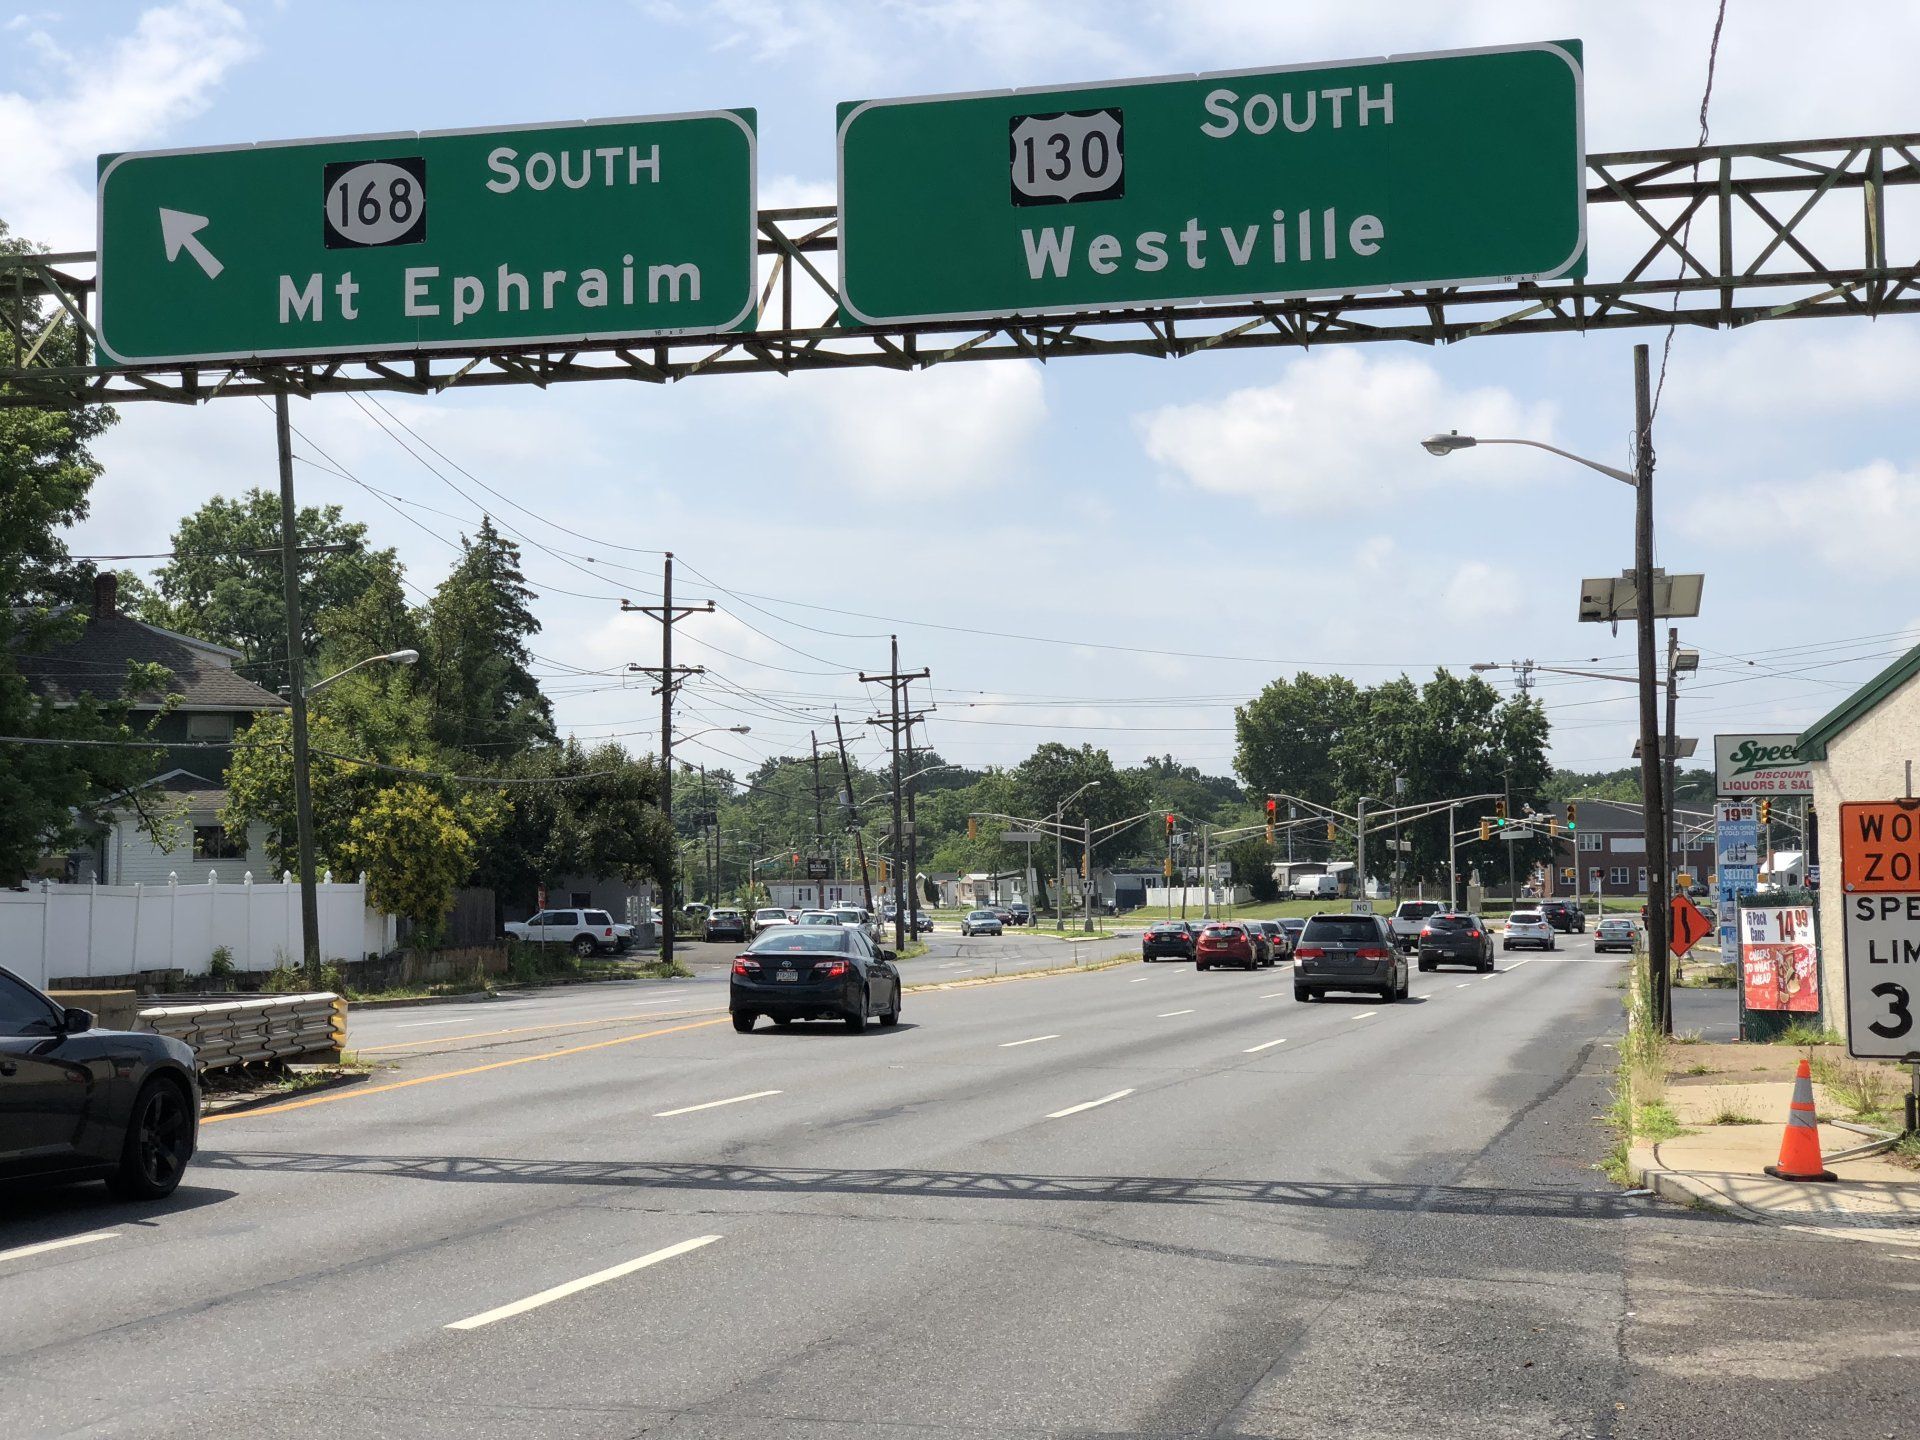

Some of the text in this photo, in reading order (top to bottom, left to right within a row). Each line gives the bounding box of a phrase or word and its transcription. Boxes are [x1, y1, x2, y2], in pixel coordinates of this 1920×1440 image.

[1200, 82, 1394, 139] SOUTH
[486, 145, 660, 194] SOUTH
[1024, 131, 1110, 184] 130
[340, 174, 413, 228] 168
[1022, 208, 1385, 280] Westville
[279, 254, 701, 326] Mt Ephraim
[1729, 740, 1799, 769] Spee
[1723, 781, 1774, 791] LIQUORS
[1778, 780, 1787, 790] &
[1754, 771, 1810, 779] DISCOUNT
[1858, 813, 1920, 843] WO
[1724, 869, 1754, 880] SELTZER
[1864, 852, 1920, 882] ZO
[1746, 912, 1767, 926] 15 Pack
[1750, 927, 1765, 942] Cans
[1745, 960, 1776, 973] TO WHAT'S
[1748, 948, 1771, 960] CHEERS
[1751, 973, 1771, 986] AHEAD
